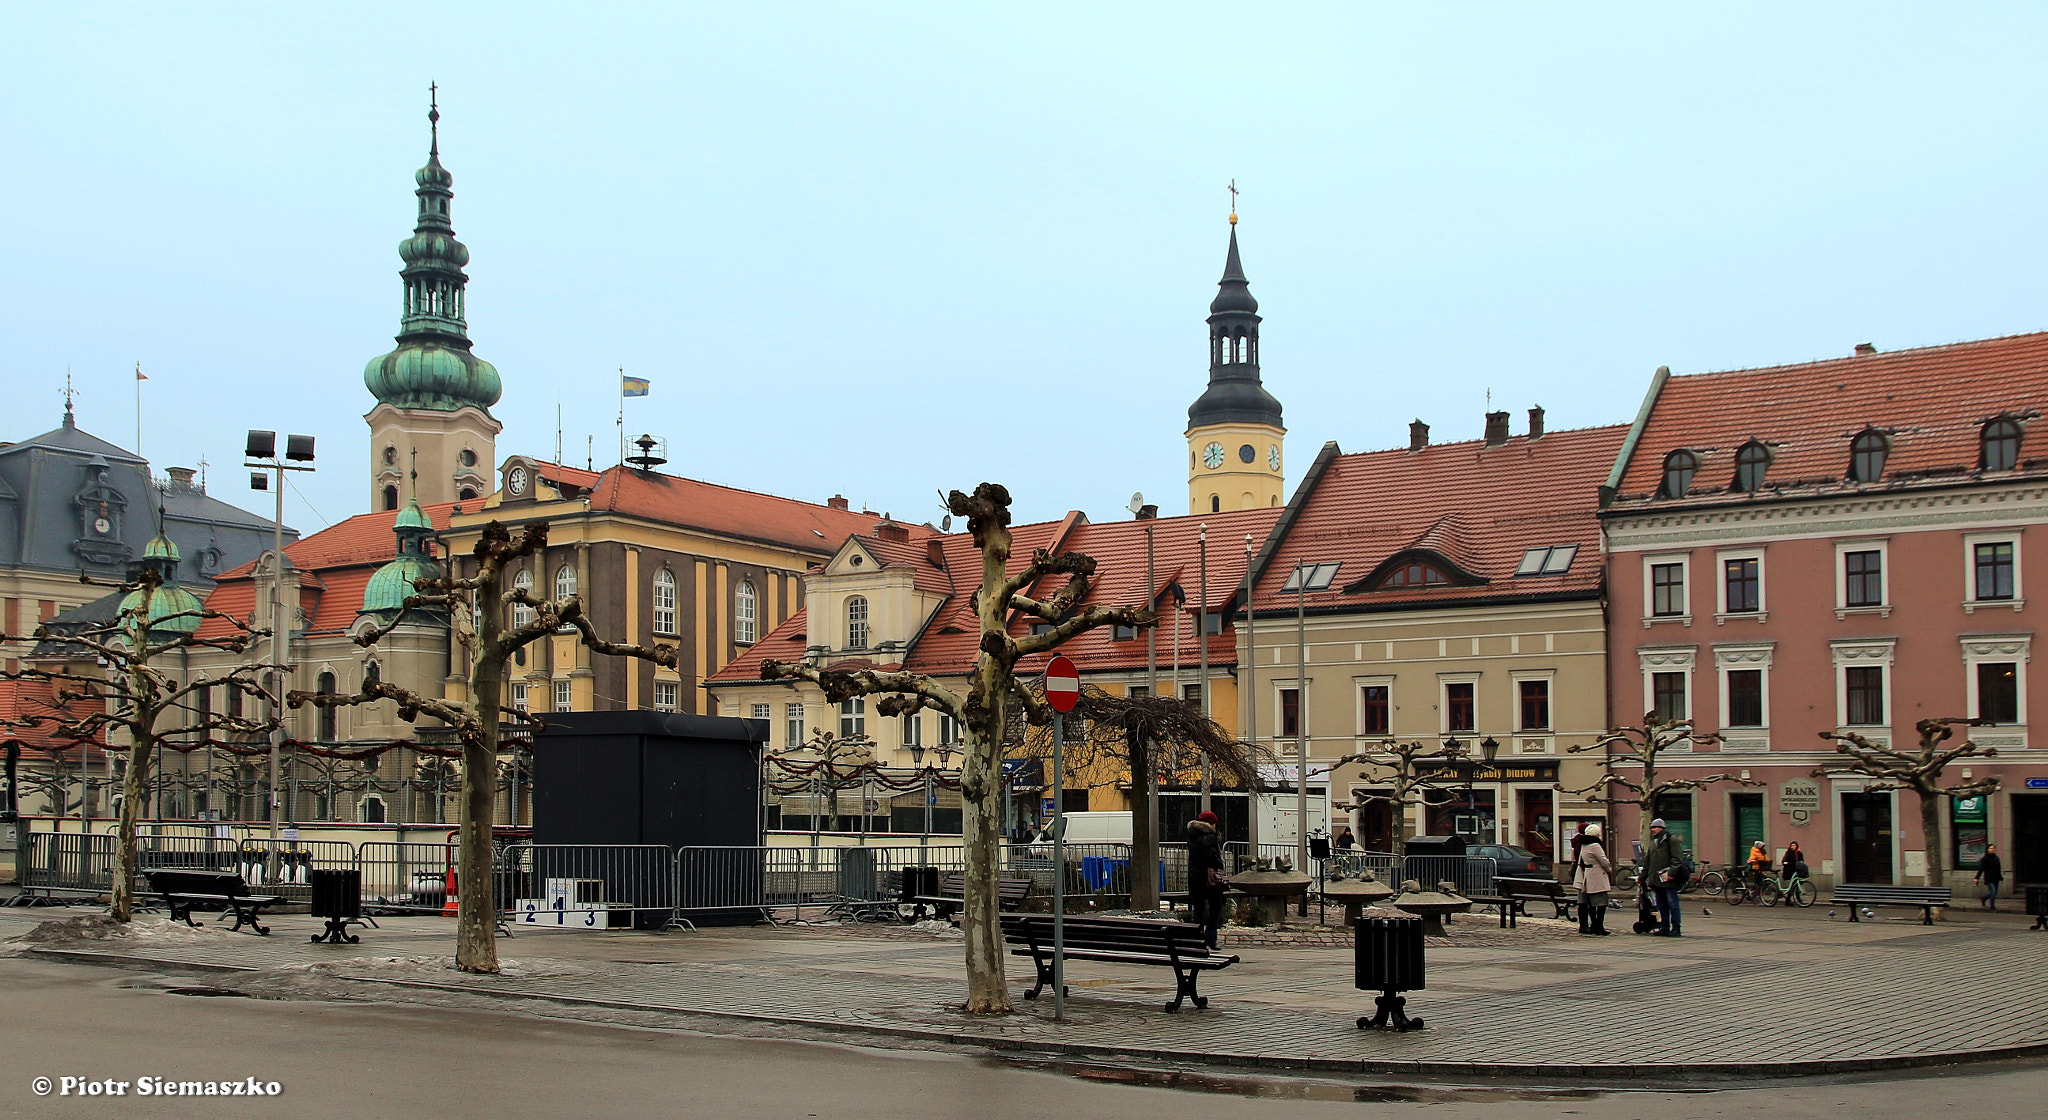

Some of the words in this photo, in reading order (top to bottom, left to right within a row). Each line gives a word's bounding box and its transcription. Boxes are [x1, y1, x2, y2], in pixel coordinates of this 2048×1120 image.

[1785, 787, 1816, 795] BANK
[525, 904, 536, 922] 2
[584, 907, 596, 926] 3
[553, 897, 564, 925] 1
